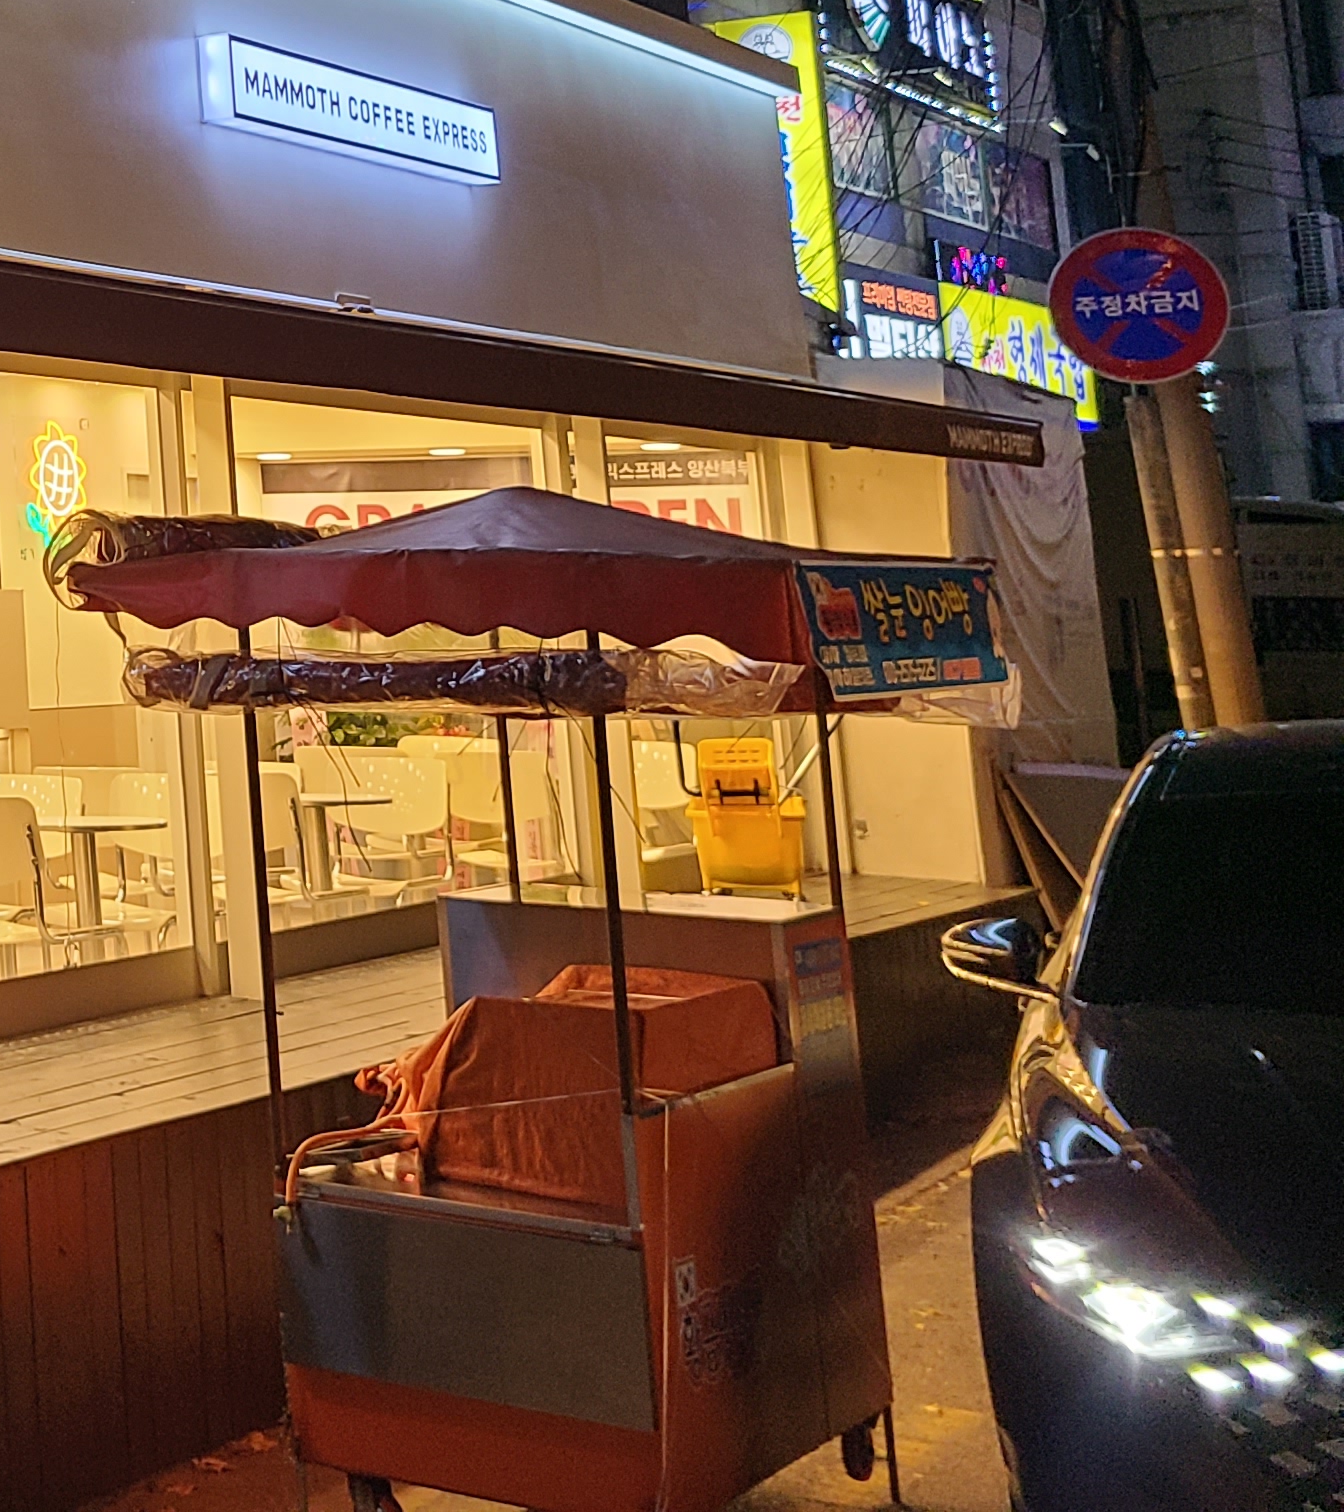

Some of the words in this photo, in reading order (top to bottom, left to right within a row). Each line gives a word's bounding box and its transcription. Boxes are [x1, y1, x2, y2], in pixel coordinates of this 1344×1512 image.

[244, 67, 342, 119] MAMMOTH
[348, 95, 416, 135] COFFEE
[422, 114, 487, 155] EXPRESS
[1075, 292, 1201, 318] 주정차금지
